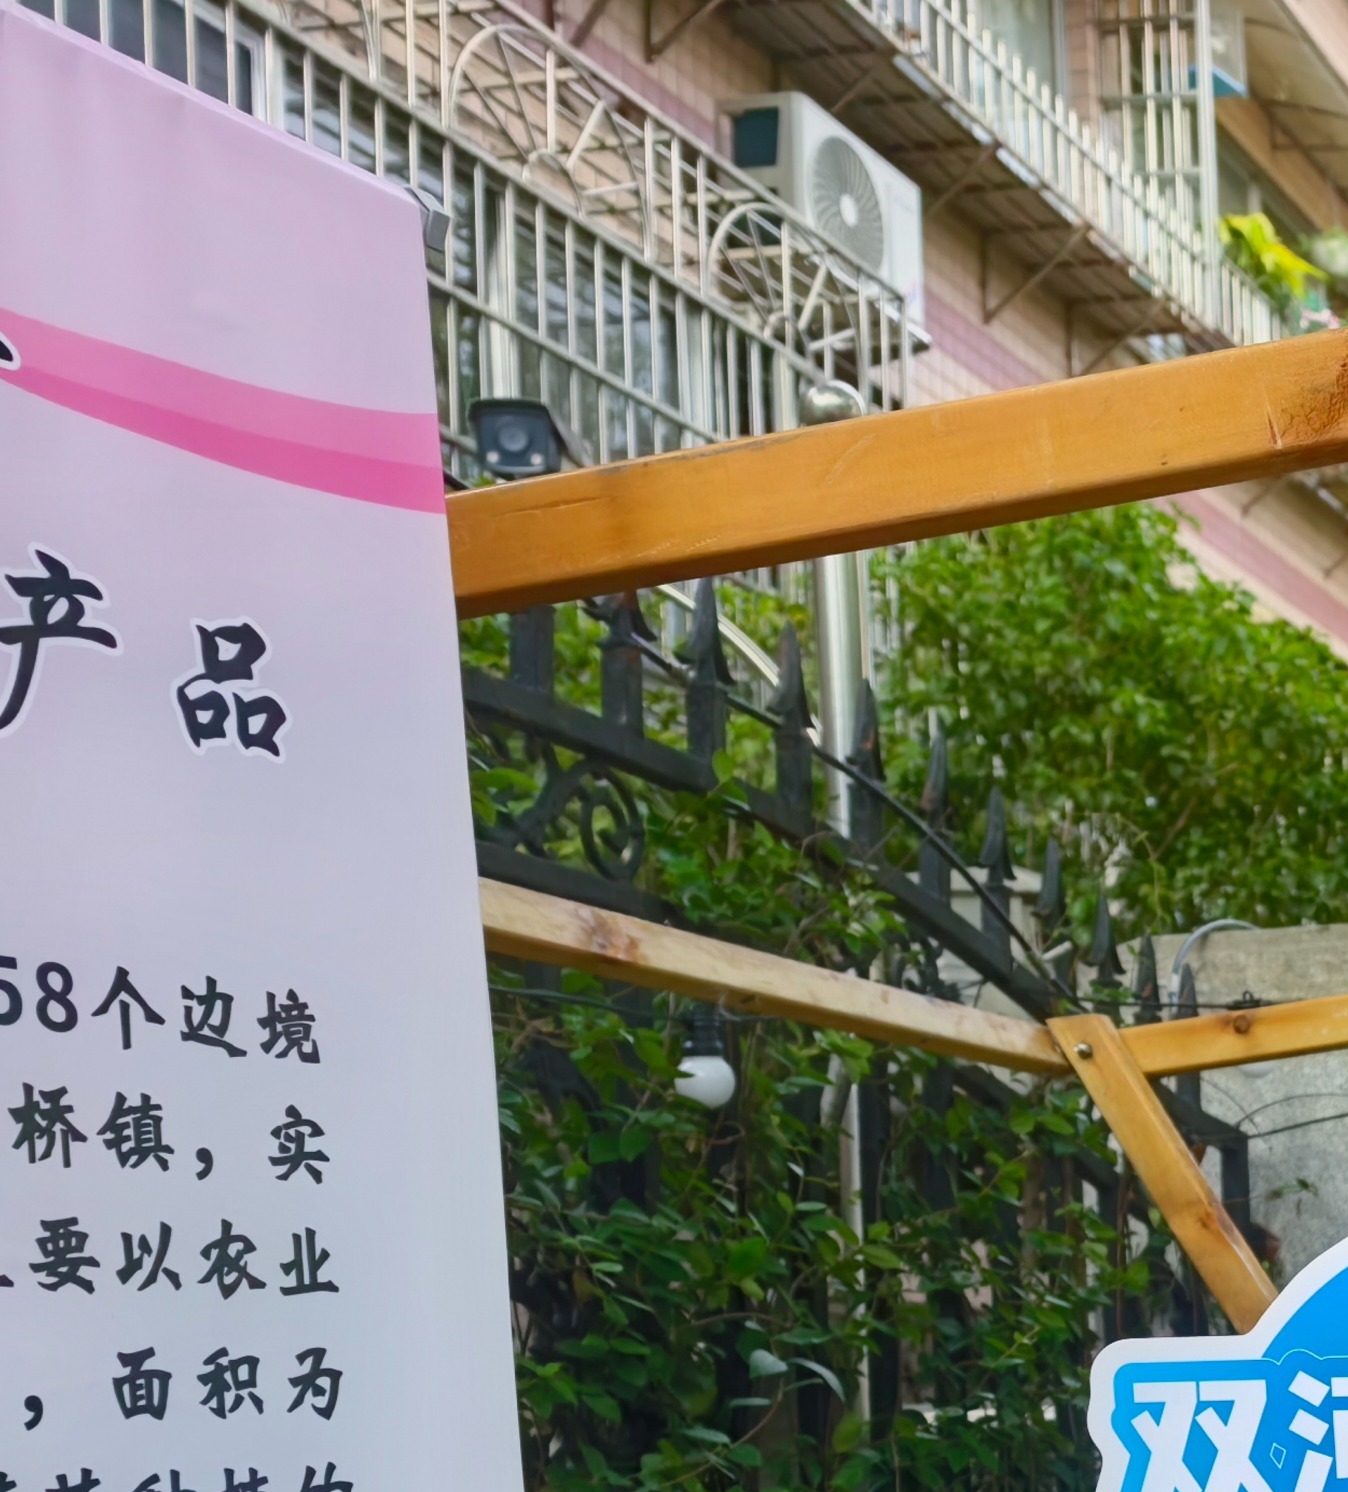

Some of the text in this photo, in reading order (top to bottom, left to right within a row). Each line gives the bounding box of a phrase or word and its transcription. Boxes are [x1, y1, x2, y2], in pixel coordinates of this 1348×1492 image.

[0, 548, 287, 758] 产品
[0, 1216, 340, 1300] 要以农业
